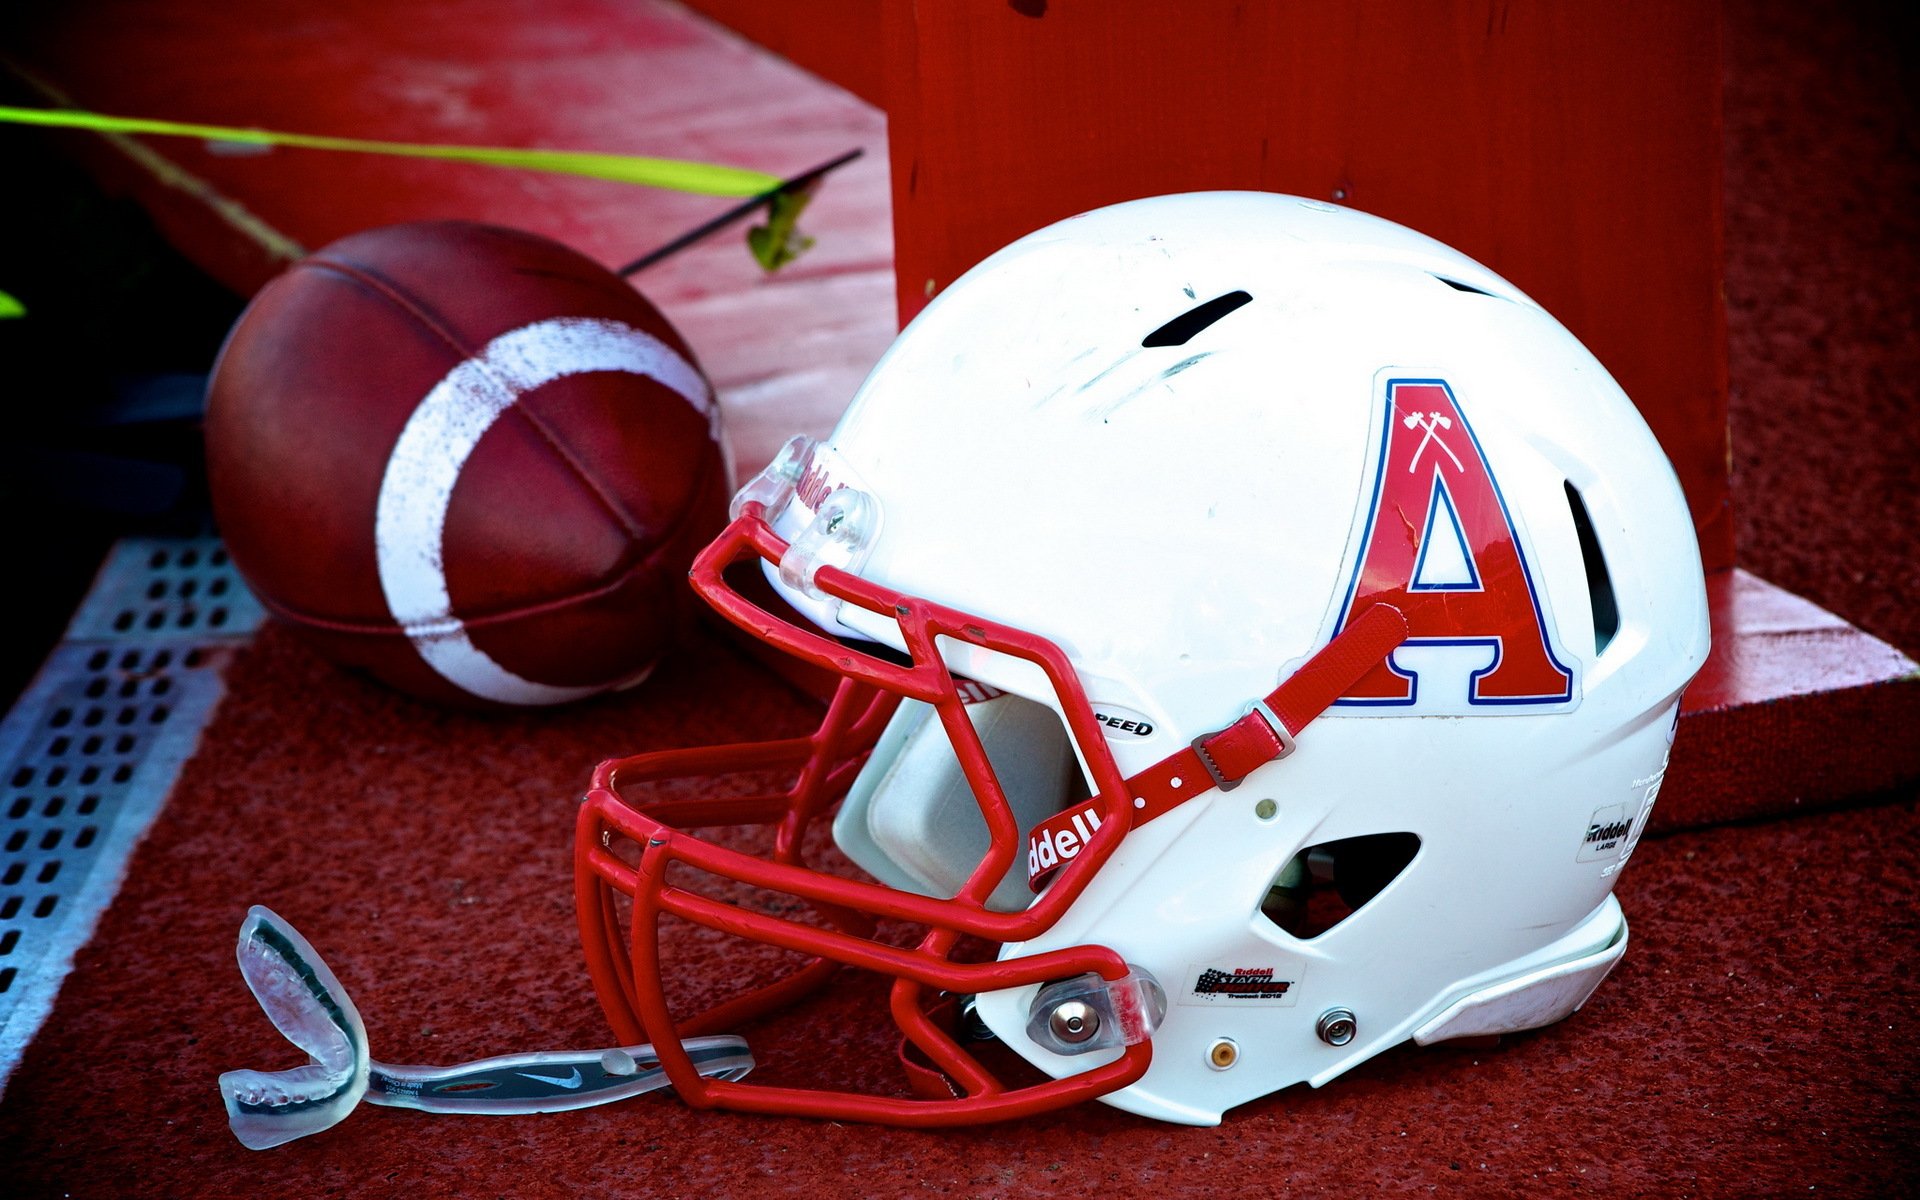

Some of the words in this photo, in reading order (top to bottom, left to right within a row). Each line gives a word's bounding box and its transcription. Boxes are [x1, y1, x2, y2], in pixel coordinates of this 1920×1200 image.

[1330, 378, 1573, 706] A
[1095, 713, 1154, 736] PEED
[1028, 807, 1102, 878] ddell
[1595, 840, 1618, 851] LARGE
[1234, 968, 1274, 976] Riddell
